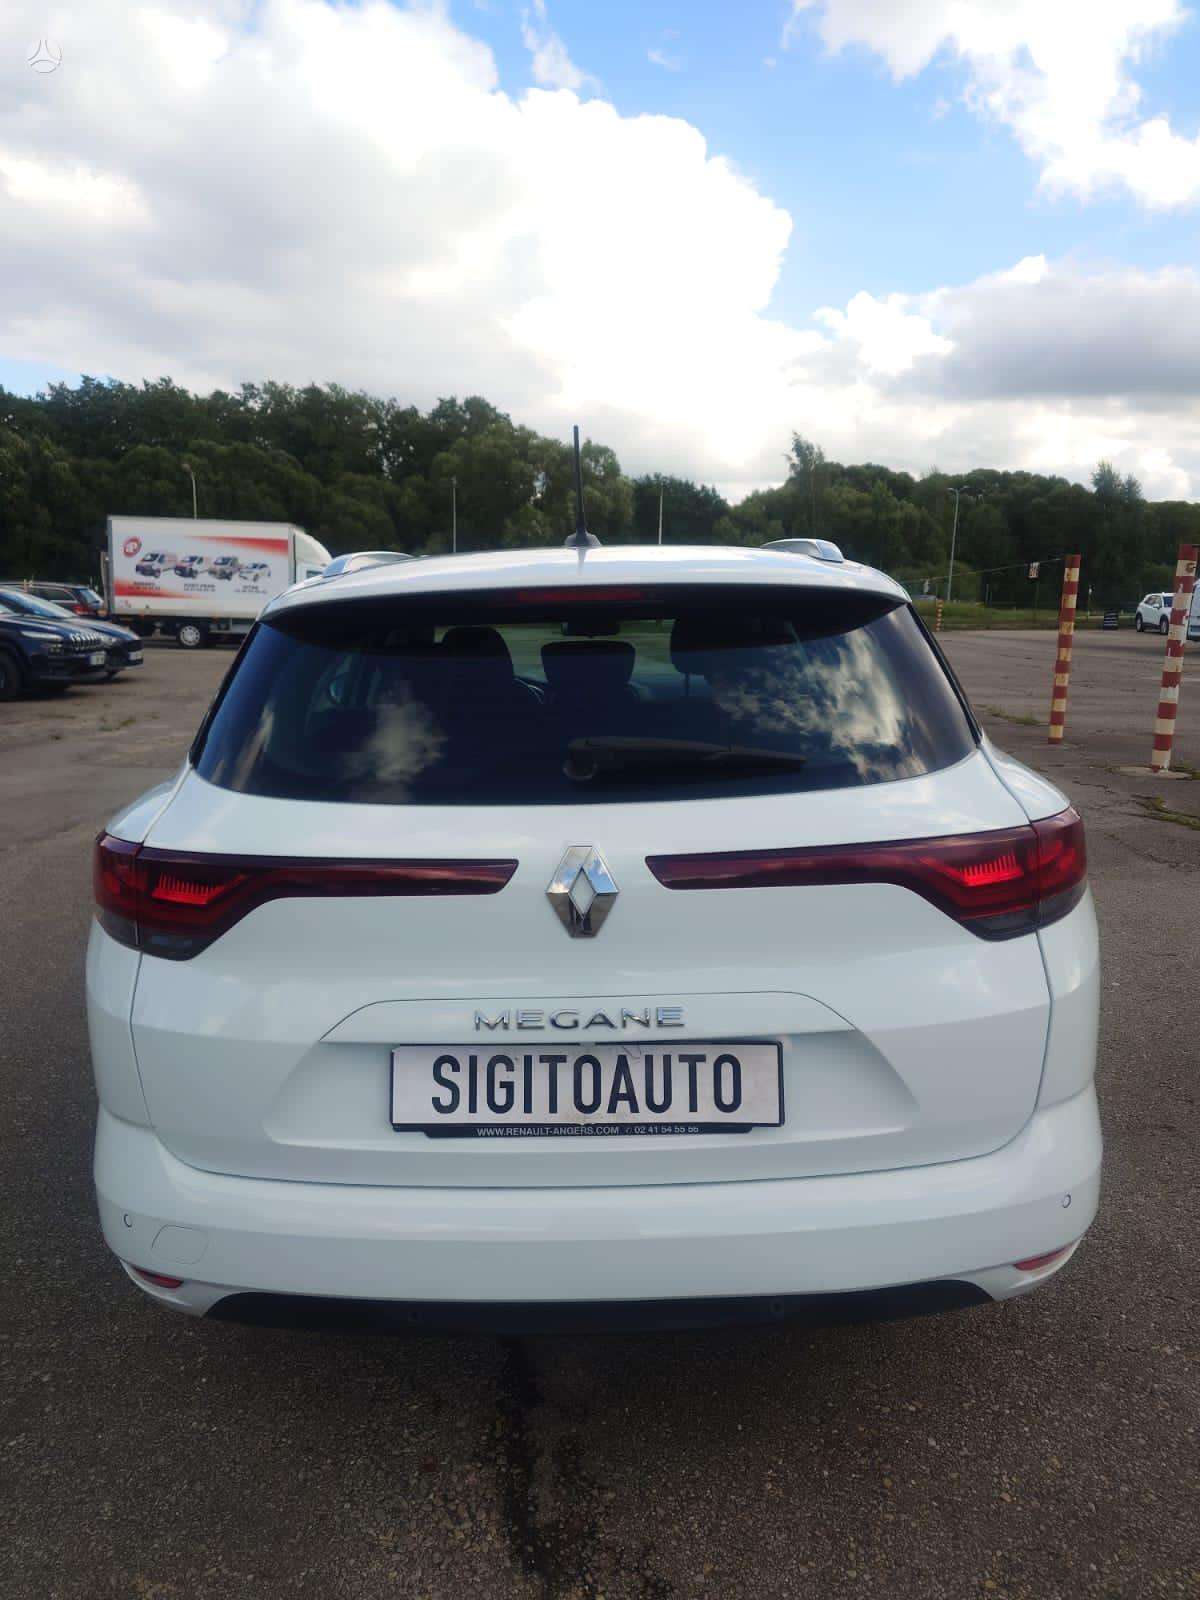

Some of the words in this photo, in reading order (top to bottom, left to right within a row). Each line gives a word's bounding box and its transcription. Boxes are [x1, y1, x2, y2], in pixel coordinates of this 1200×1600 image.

[474, 1006, 686, 1031] MEGANE
[431, 1053, 743, 1115] SIGITOAUTO
[477, 1126, 618, 1136] WWW.RENAULT-ANGERS.COM
